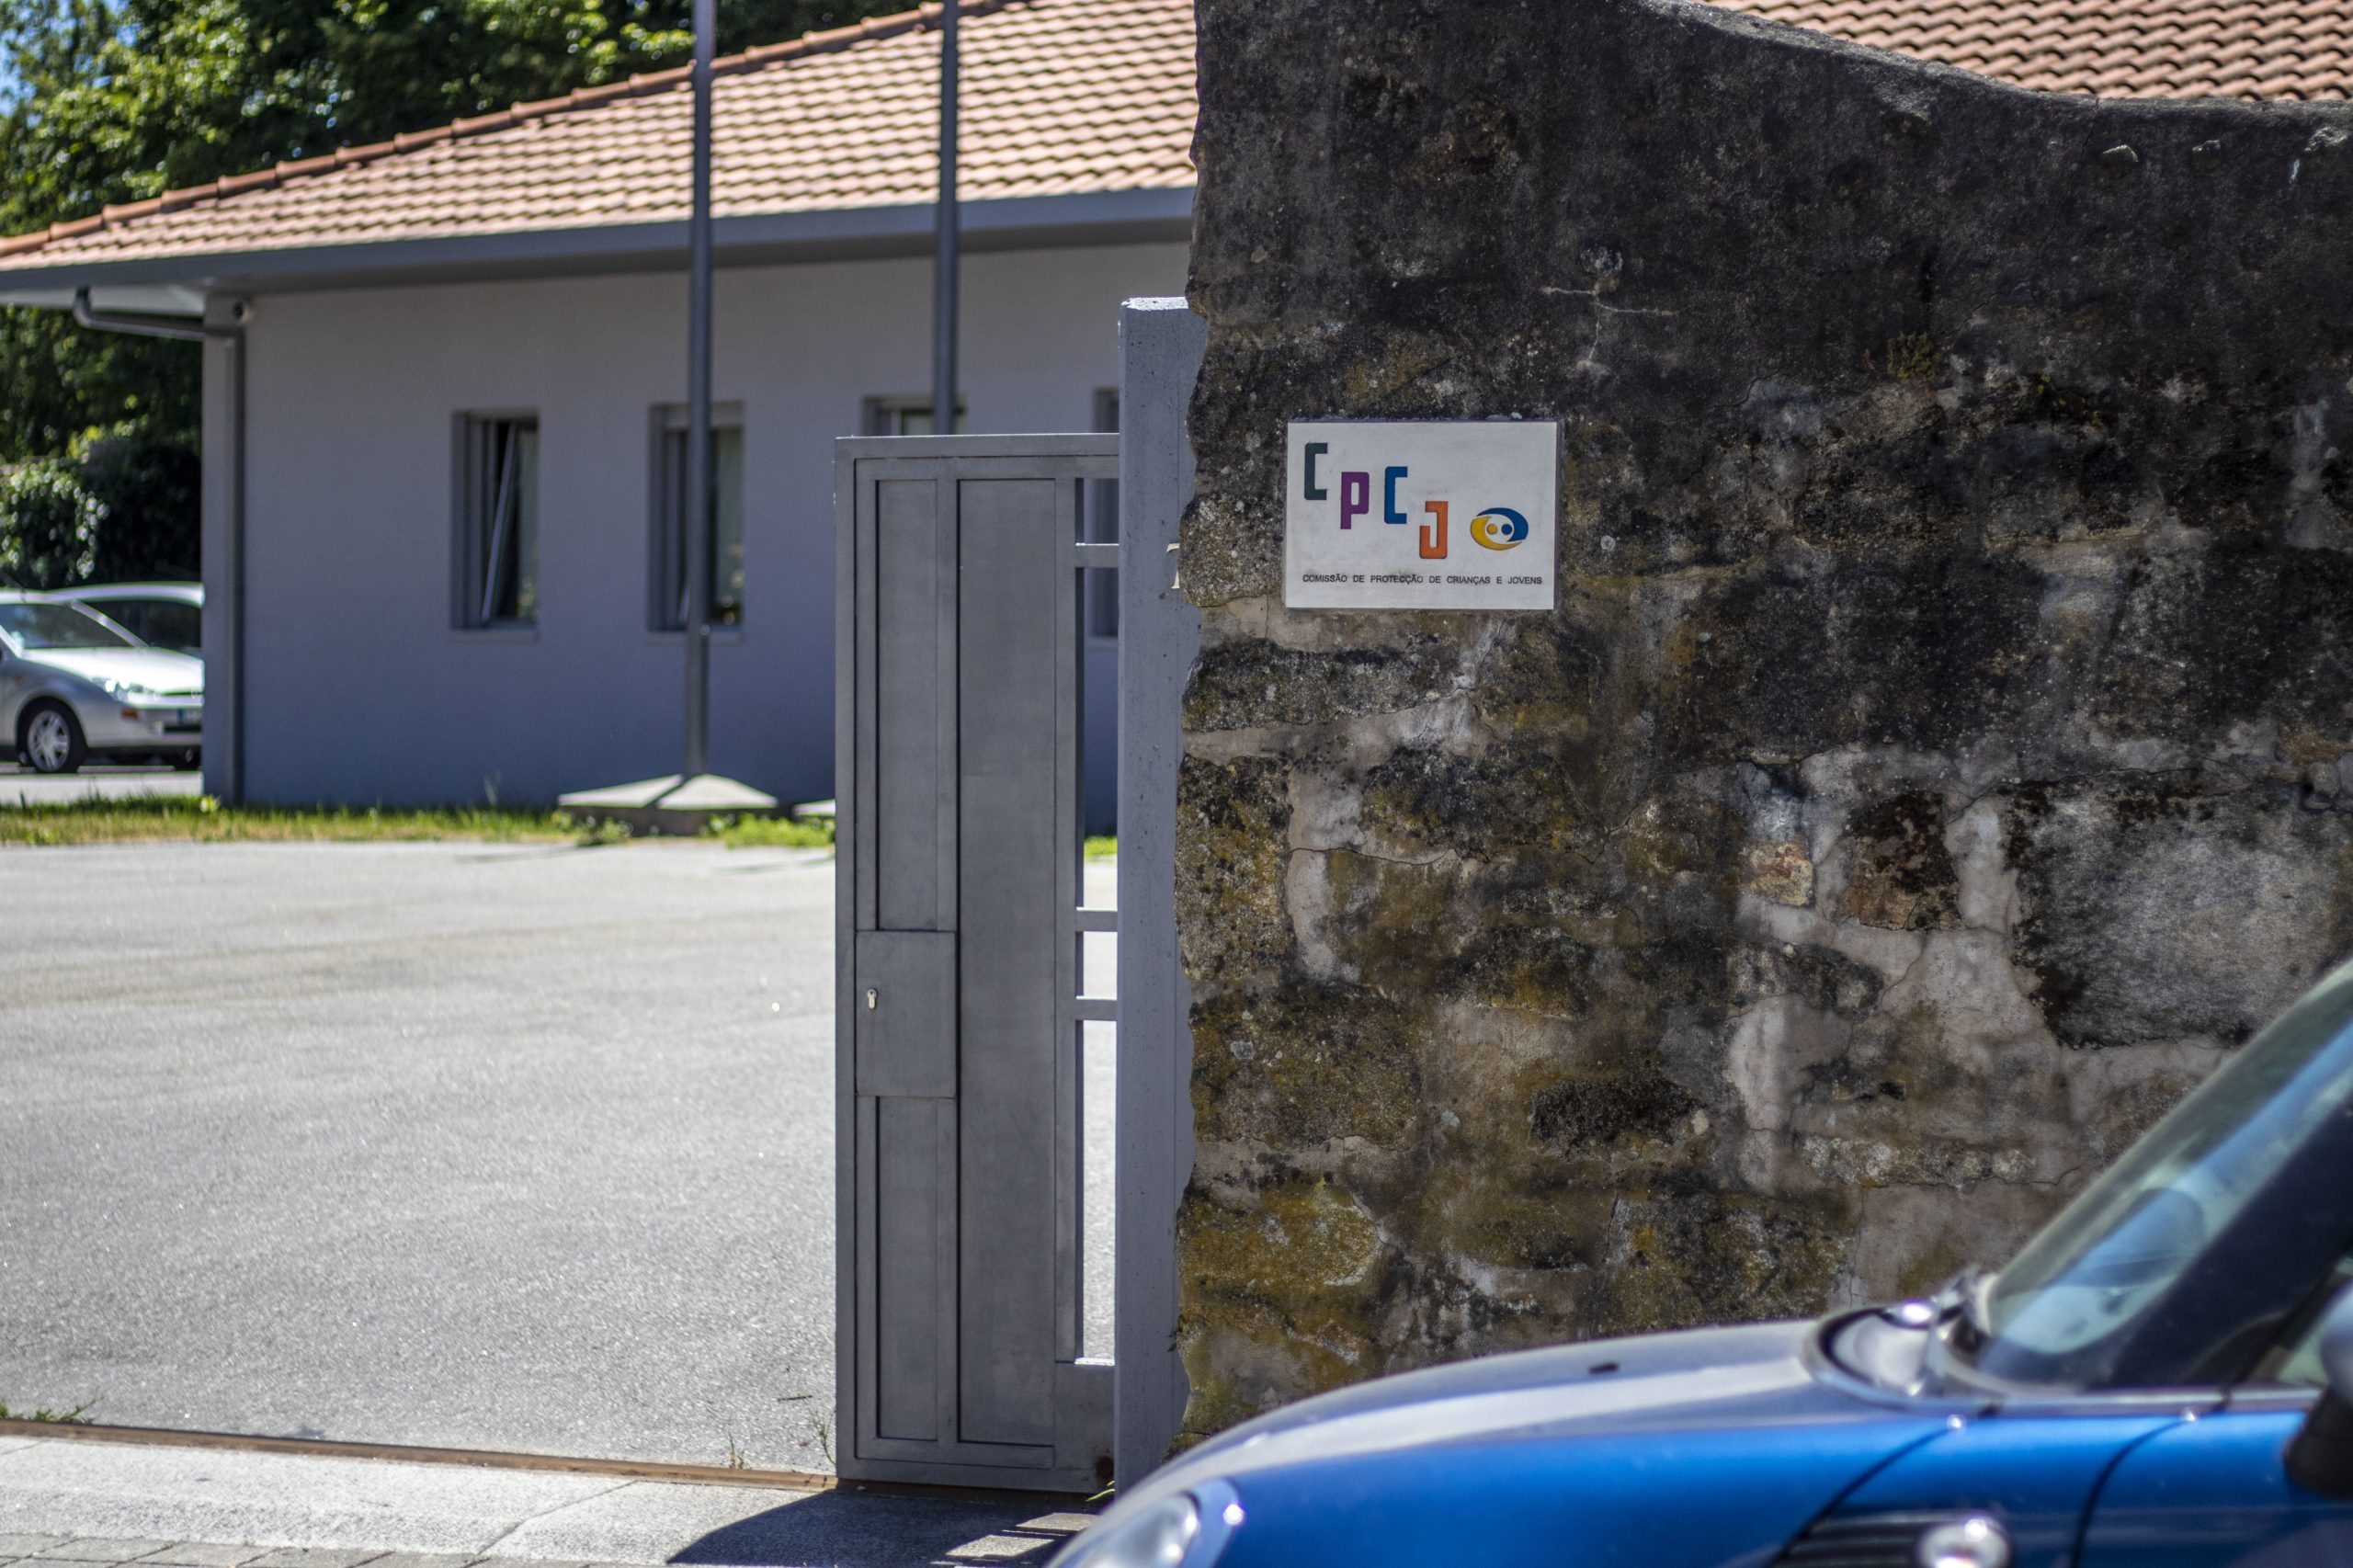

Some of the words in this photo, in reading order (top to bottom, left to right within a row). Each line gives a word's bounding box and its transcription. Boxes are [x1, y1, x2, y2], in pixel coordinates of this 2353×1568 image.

[1303, 442, 1449, 559] CPCJ
[1302, 573, 1347, 583] COMISSÃO
[1370, 574, 1424, 585] PROTECÇÃO
[1428, 575, 1441, 584] DE
[1447, 575, 1491, 585] CRIANÇAS
[1507, 575, 1542, 585] JOVENS
